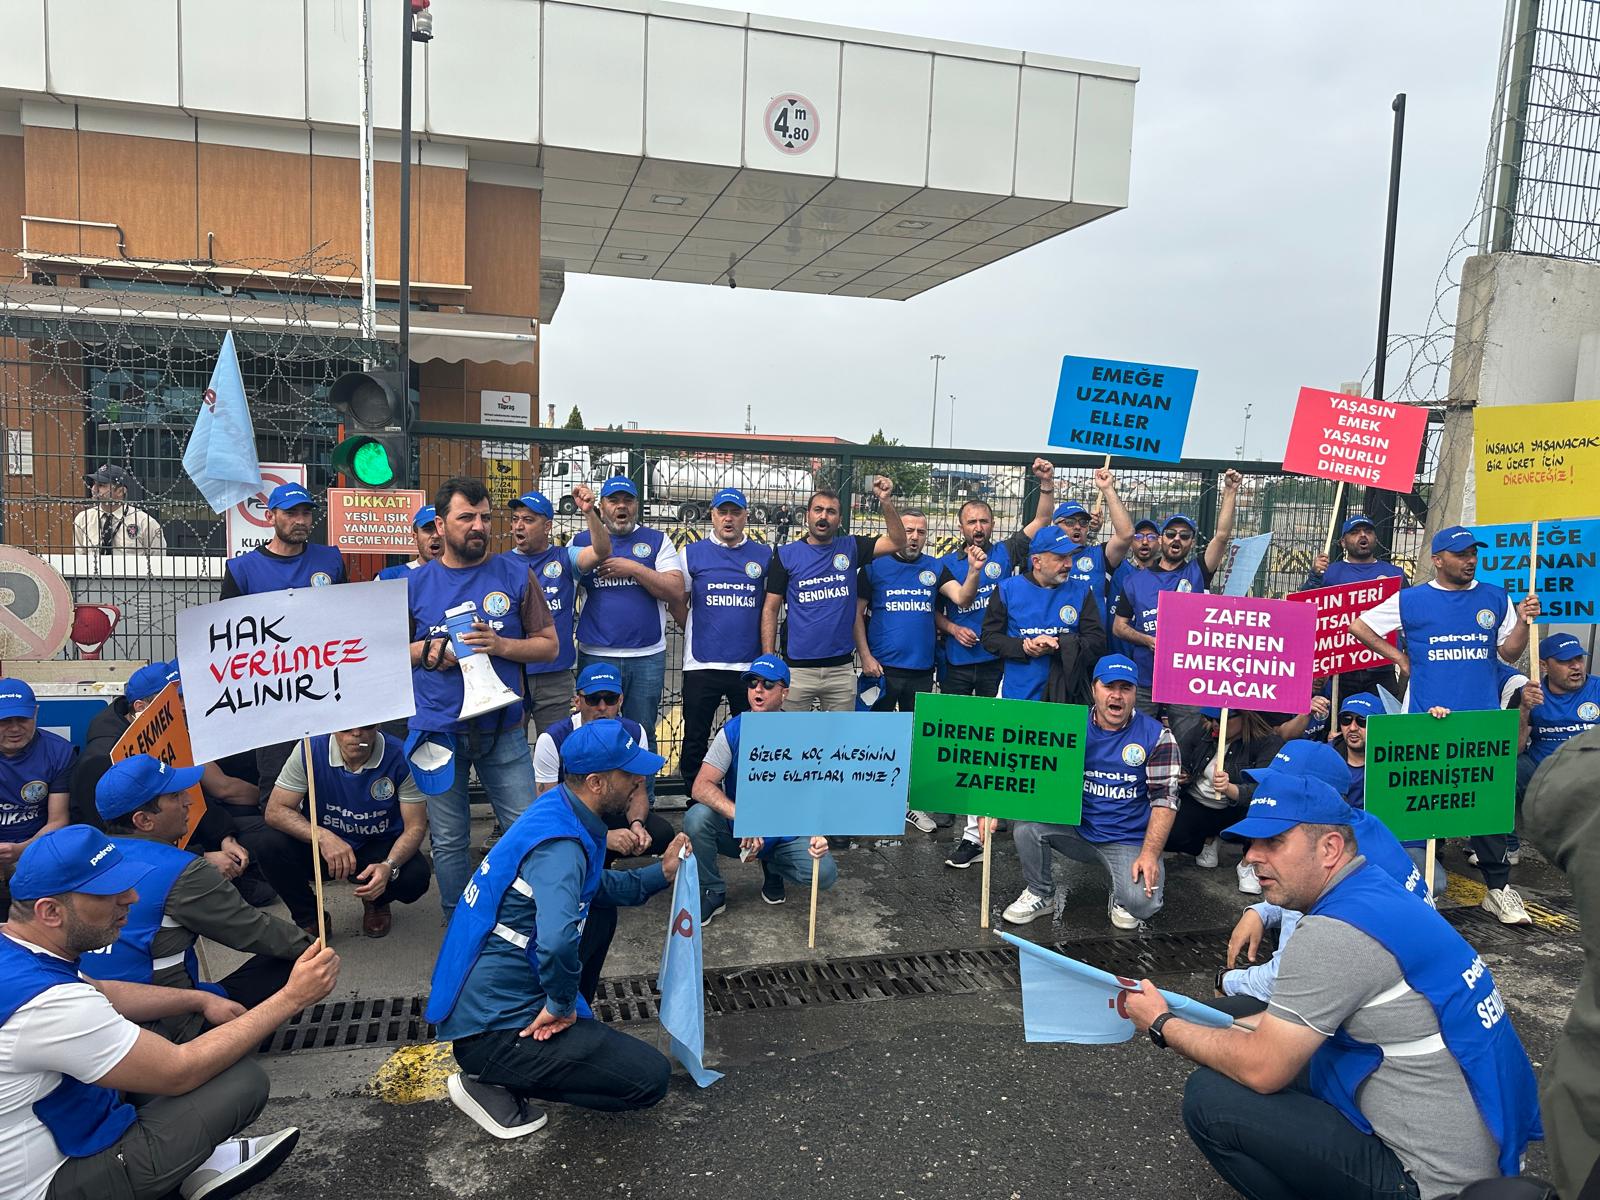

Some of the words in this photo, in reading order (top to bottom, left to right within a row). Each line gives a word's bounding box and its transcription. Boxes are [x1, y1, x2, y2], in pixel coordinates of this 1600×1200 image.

[1091, 366, 1165, 388] EMEĞE
[1076, 386, 1172, 411] UZANAN
[1328, 397, 1397, 419] YAŞASIN
[1090, 409, 1149, 430] ELLER
[1337, 414, 1382, 432] EMEK
[1070, 428, 1161, 454] KIRILSIN
[1322, 427, 1390, 450] YAŞASIN
[1485, 438, 1524, 455] İNSANCA
[1318, 443, 1387, 466] ONURLU
[1486, 458, 1503, 472] BİR
[1317, 458, 1382, 483] DİRENİŞ
[343, 495, 411, 508] DİKKAT!
[343, 524, 412, 533] YANMADAN
[345, 512, 379, 523] YEŞİL
[383, 513, 408, 523] IŞIK
[338, 534, 415, 546] GEÇMEYİNİZ
[1495, 525, 1581, 549] EMEĞE
[1481, 551, 1596, 572] UZANAN
[705, 594, 756, 608] SENDİKASI
[798, 586, 850, 603] SENDİKASI
[885, 599, 932, 612] SENDİKASI
[1348, 583, 1384, 606] TERİ
[1203, 607, 1272, 628] ZAFER
[209, 615, 292, 653] HAK
[1187, 626, 1285, 653] DİRENEN
[209, 638, 368, 684] VERİLMEZ
[1312, 652, 1345, 675] EÇİT
[1427, 644, 1489, 662] SENDİKASI
[1172, 652, 1295, 678] EMEKÇİNİN
[1188, 677, 1277, 700] OLACAK
[921, 718, 996, 742] DİRENE
[1002, 724, 1078, 749] DİRENE
[749, 744, 793, 762] BİZLER
[801, 747, 824, 765] KOÇ
[830, 744, 896, 762] AİLESİNİN
[937, 746, 1058, 773] DİRENİŞTEN
[1373, 742, 1440, 763] DİRENE
[1446, 737, 1511, 759] DİRENE
[748, 767, 777, 782] ÜVEY
[783, 769, 844, 783] EVLATLARI
[955, 772, 1036, 794] ZAFERE!
[1083, 769, 1138, 782] etrol-iş
[1388, 763, 1494, 789] DİRENİŞTEN
[1083, 780, 1138, 800] ENDİKASI
[1406, 791, 1476, 812] ZAFERE!
